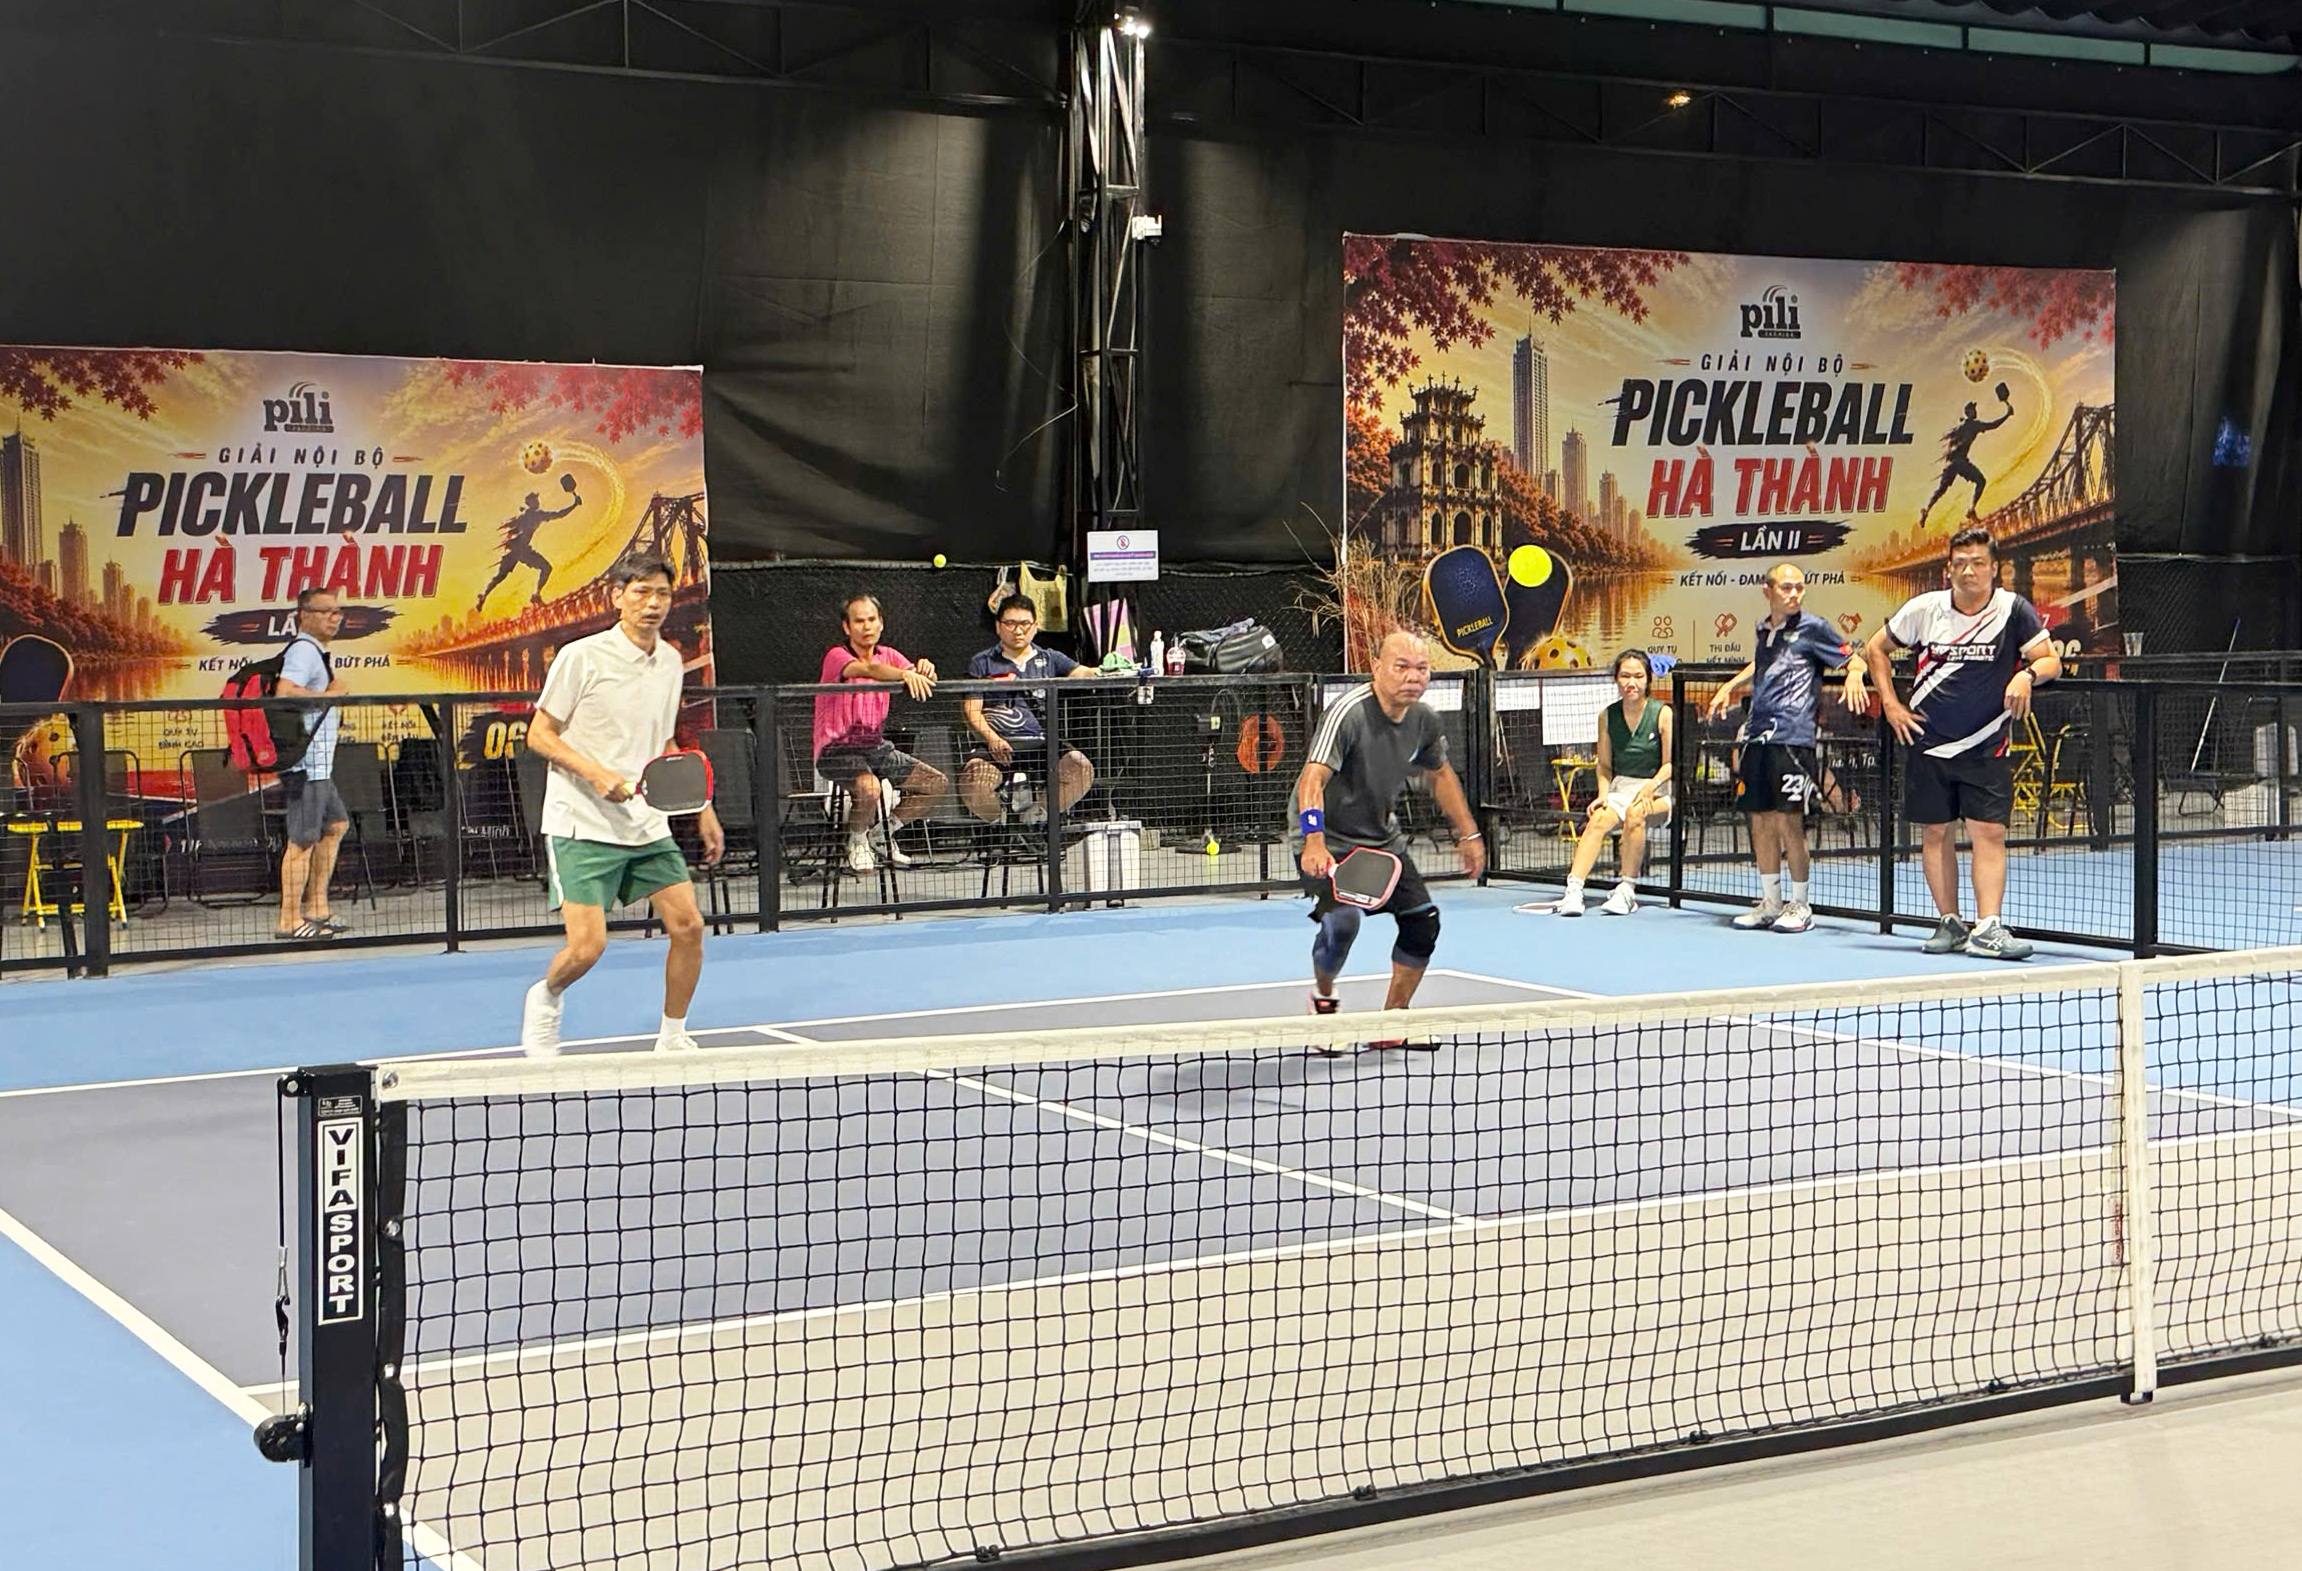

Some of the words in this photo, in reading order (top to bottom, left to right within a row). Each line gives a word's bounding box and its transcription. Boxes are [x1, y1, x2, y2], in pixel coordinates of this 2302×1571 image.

[1740, 285, 1801, 338] pili
[1701, 349, 1751, 371] GIẢI
[1766, 352, 1804, 376] NỘI
[1818, 353, 1843, 377] BỘ
[263, 382, 333, 432] pili
[1611, 378, 1914, 446] PICKLEBALL
[219, 442, 277, 464] GIẢI
[294, 445, 338, 468] NỘI
[354, 446, 384, 469] BỘ
[1646, 445, 1714, 518] HÀ
[1734, 442, 1894, 516] THÀNH
[116, 472, 468, 537] PICKLEBALL
[1740, 525, 1783, 551] LẦN
[1787, 530, 1801, 550] II
[157, 532, 237, 605] HÀ
[259, 531, 444, 603] THÀNH
[1680, 570, 1703, 587] KẾT
[1706, 569, 1727, 586] NỐI
[1804, 570, 1820, 585] ỨT
[1822, 570, 1845, 585] PHÁ
[199, 656, 224, 671] KẾT
[364, 654, 390, 668] PHÁ
[1781, 773, 1805, 794] 23
